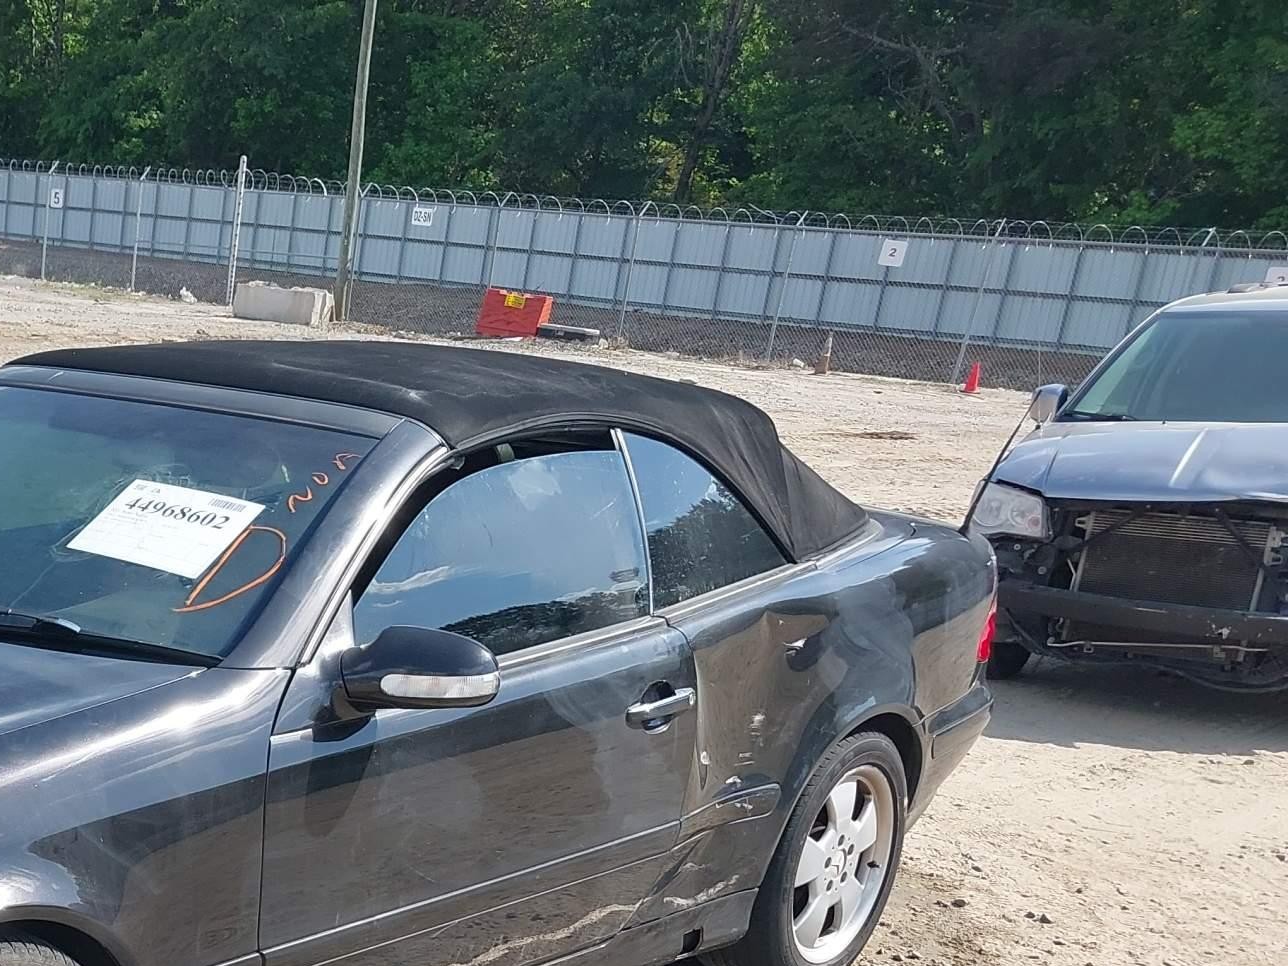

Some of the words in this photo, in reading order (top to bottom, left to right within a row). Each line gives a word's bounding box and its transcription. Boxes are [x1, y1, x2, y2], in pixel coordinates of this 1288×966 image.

[53, 191, 60, 205] 5
[888, 247, 897, 257] 2
[124, 496, 231, 530] 44968602
